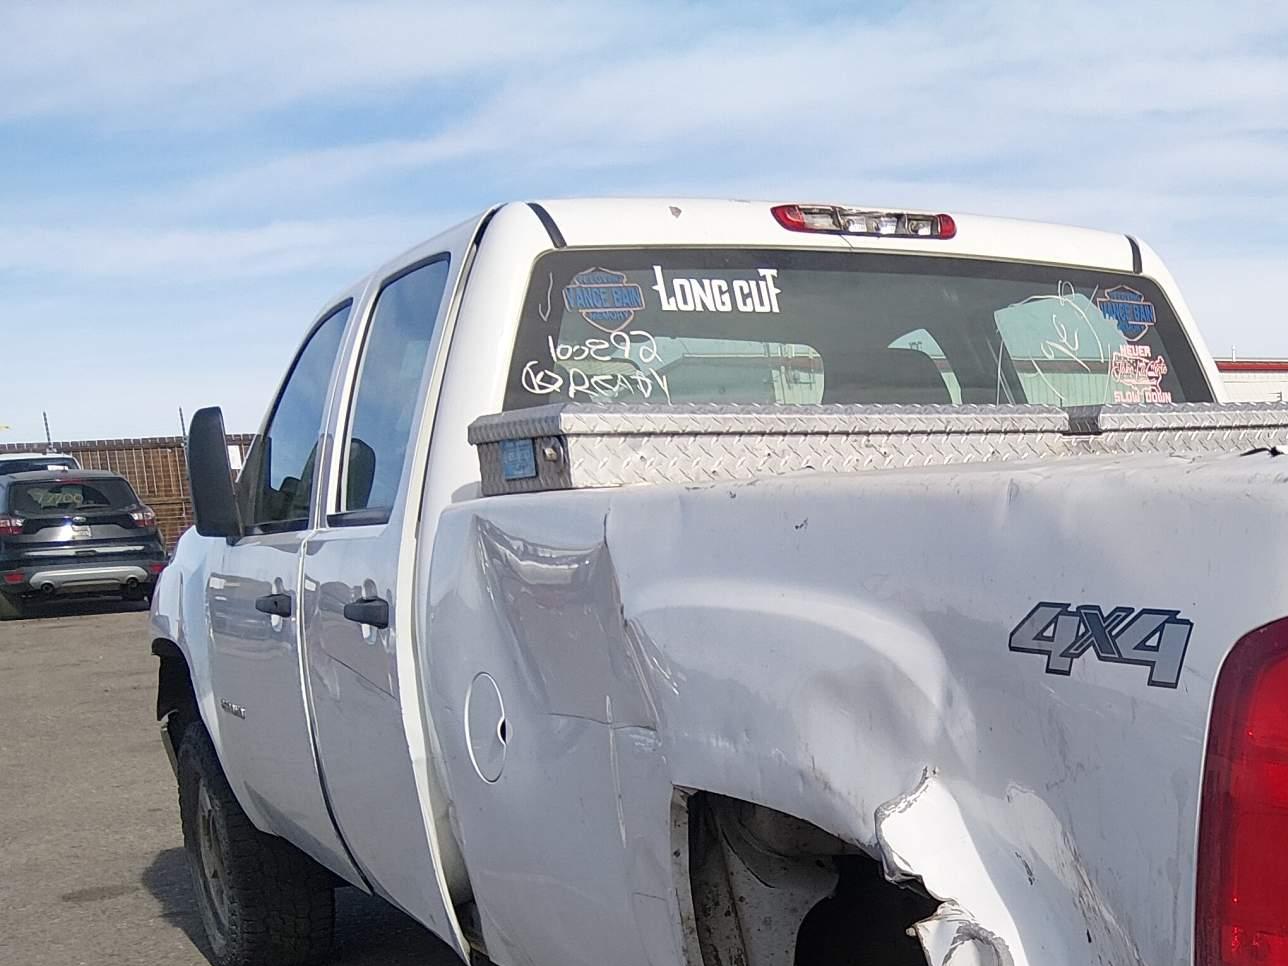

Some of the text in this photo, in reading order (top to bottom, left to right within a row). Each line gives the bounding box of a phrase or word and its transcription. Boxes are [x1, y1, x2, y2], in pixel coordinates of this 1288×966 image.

[652, 265, 781, 313] LONG CUT
[1114, 390, 1171, 404] SLOW DOWN
